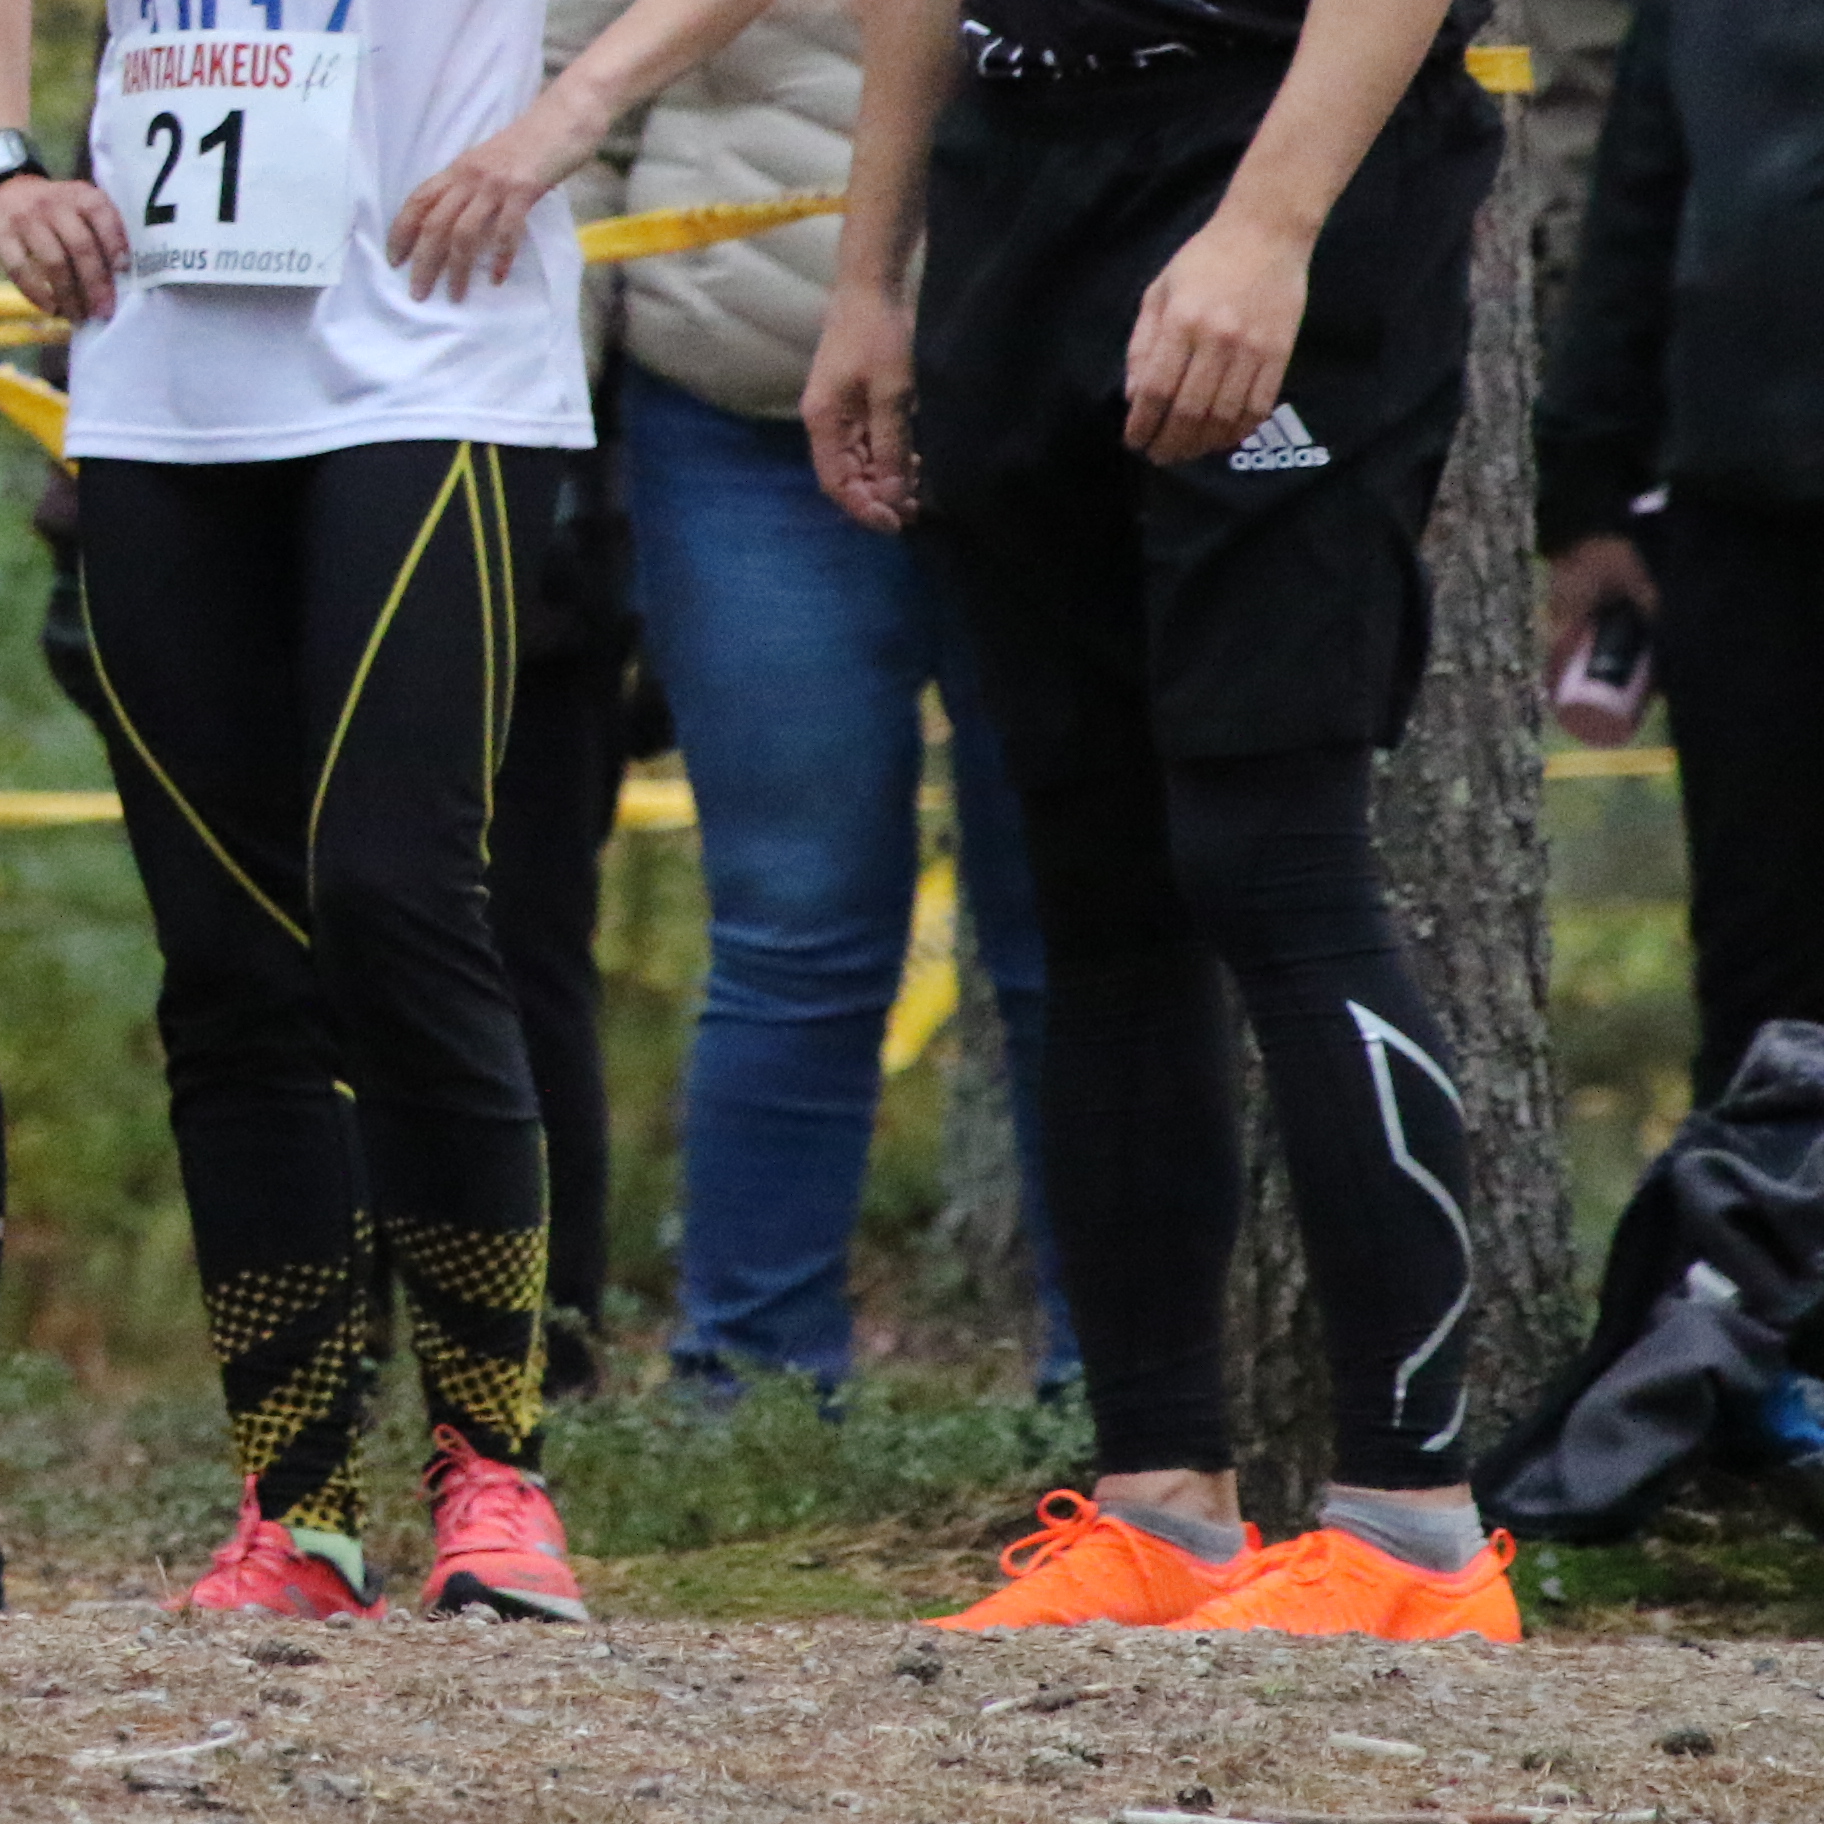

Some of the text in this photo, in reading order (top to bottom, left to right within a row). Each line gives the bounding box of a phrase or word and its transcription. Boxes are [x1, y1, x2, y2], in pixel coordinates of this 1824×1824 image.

[144, 109, 245, 227] 21
[214, 247, 312, 273] maasto
[1230, 446, 1331, 471] adidas
